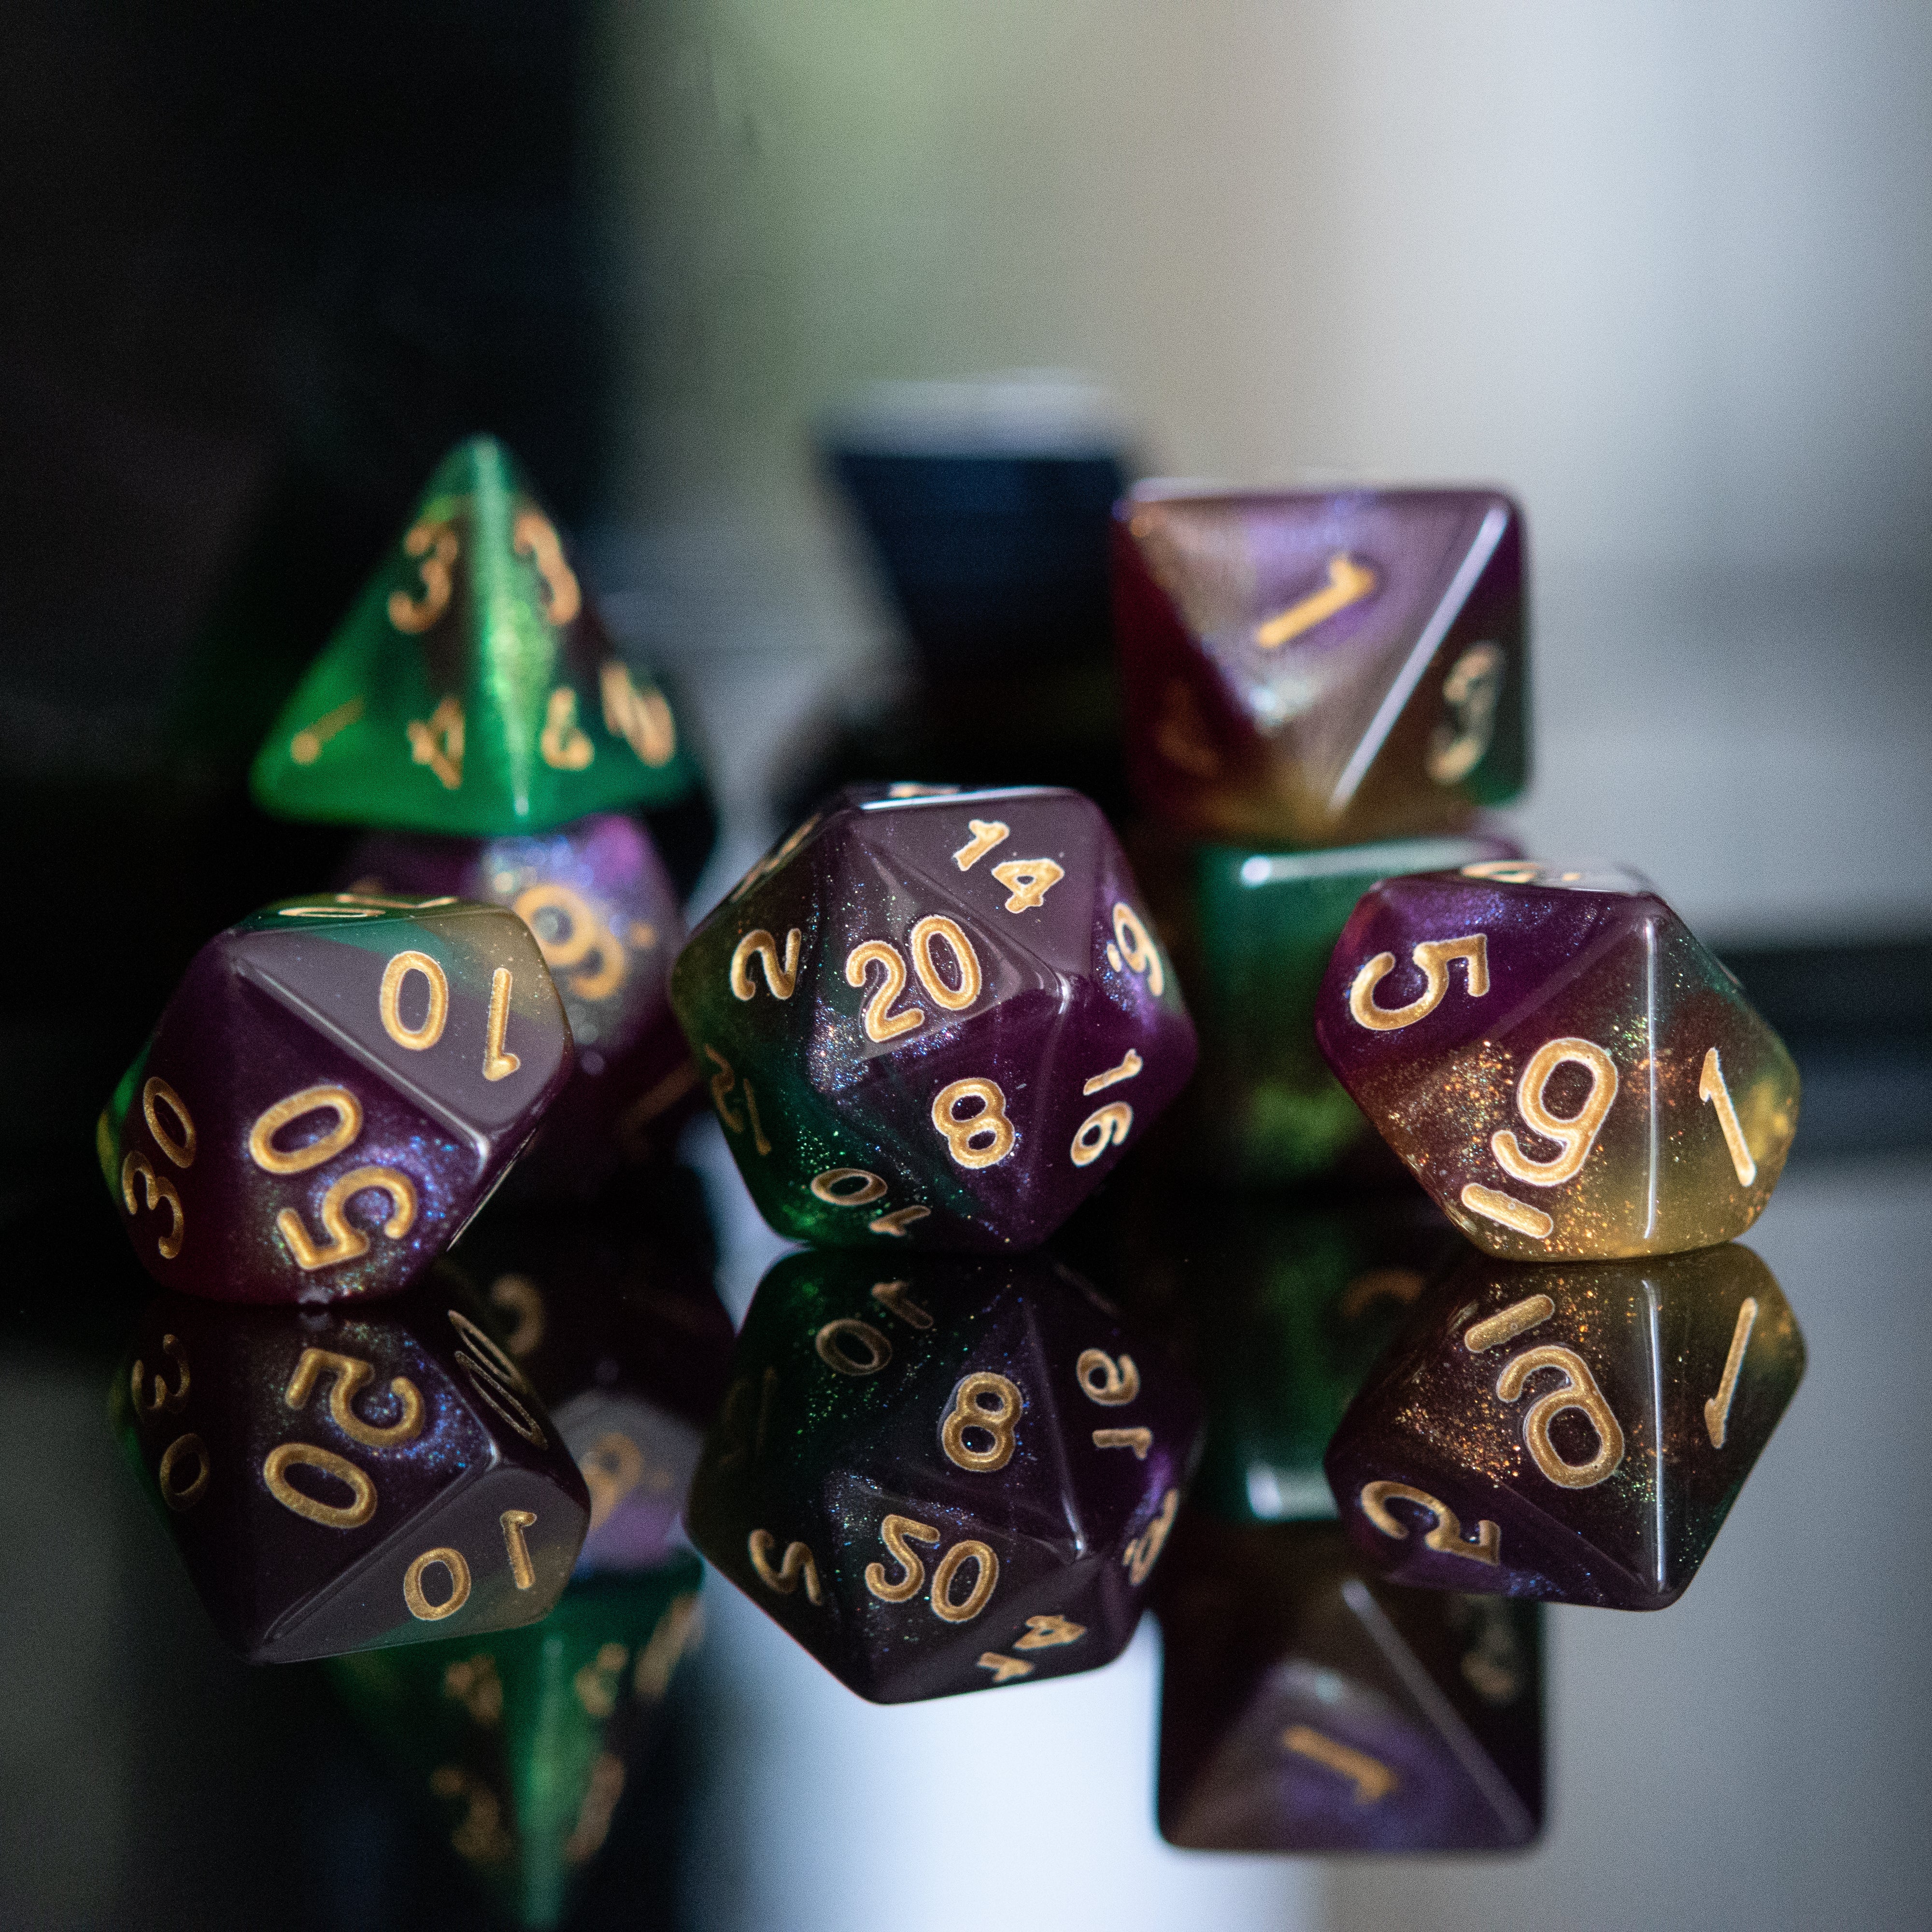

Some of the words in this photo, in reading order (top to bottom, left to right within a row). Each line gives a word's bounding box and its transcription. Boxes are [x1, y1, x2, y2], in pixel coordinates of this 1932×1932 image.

[1258, 553, 1378, 648] 1
[952, 819, 1065, 914] 14
[379, 950, 521, 1081] 10
[730, 928, 802, 1001] 2
[845, 914, 982, 1043] 20
[1350, 934, 1490, 1031] 5
[122, 1076, 196, 1259] 30
[931, 1077, 1016, 1169] 8
[1699, 1047, 1757, 1187] 1
[249, 1084, 418, 1271] 50
